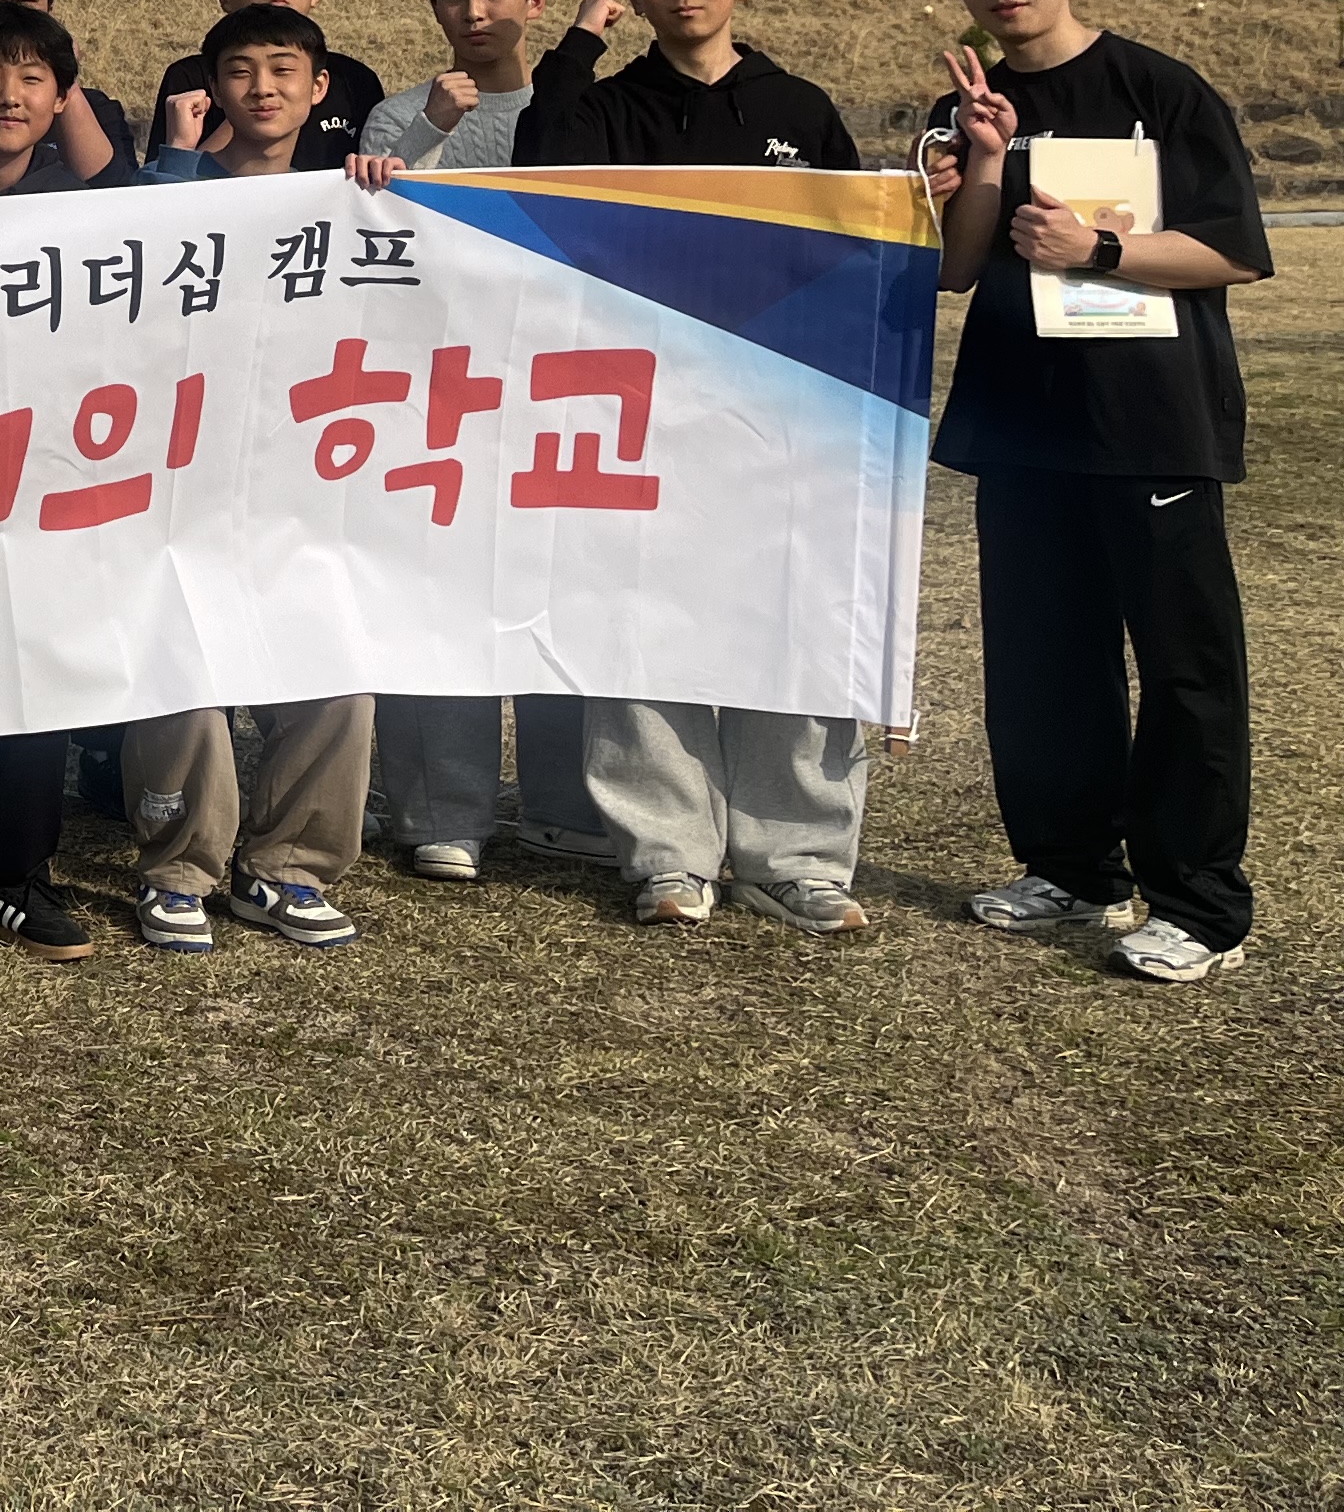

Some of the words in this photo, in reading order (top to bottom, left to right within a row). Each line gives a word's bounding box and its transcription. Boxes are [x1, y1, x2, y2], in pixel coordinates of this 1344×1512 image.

[0, 232, 226, 333] 리더십
[267, 220, 421, 303] 캠프
[289, 338, 660, 526] 학교
